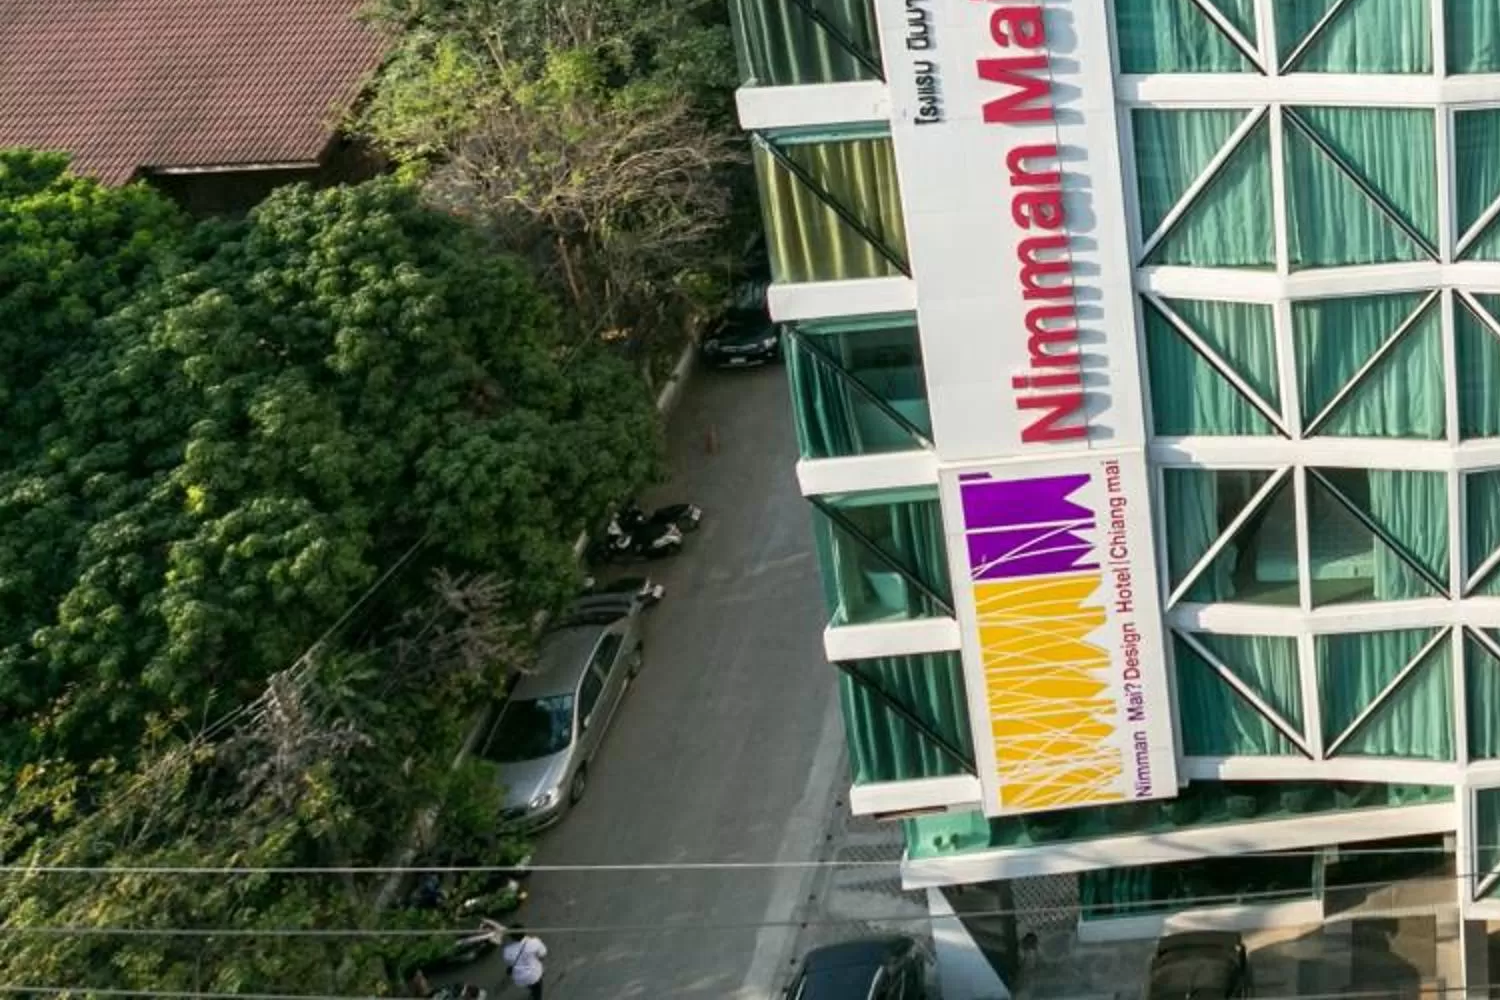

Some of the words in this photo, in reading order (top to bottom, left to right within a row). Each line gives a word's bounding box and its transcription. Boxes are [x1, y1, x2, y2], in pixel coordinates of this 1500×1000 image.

[1006, 144, 1088, 443] Nimman
[1101, 459, 1120, 493] mai
[1120, 622, 1140, 680] Design
[1124, 682, 1144, 721] Mai?
[1134, 730, 1151, 798] Nimman
